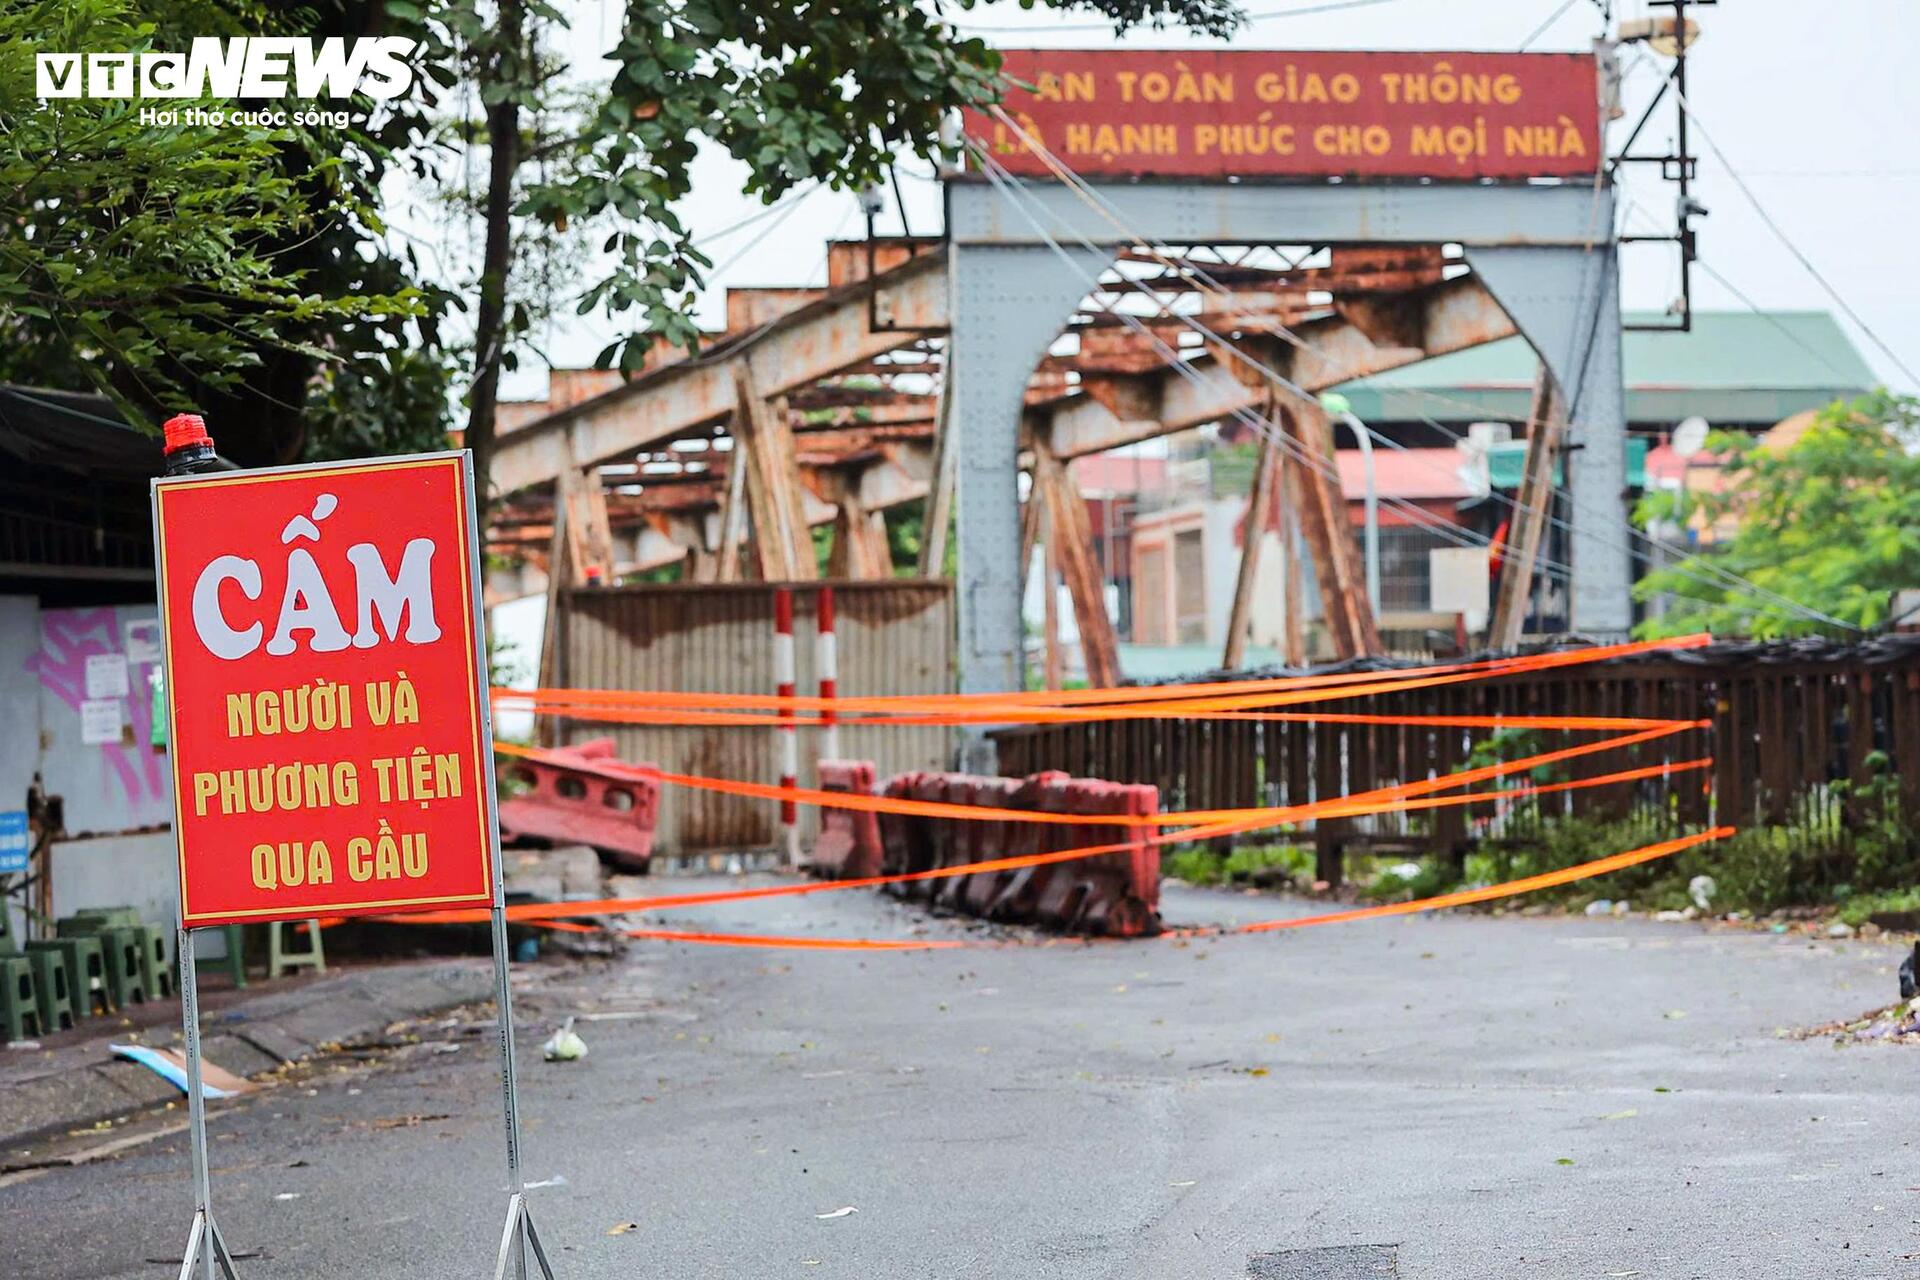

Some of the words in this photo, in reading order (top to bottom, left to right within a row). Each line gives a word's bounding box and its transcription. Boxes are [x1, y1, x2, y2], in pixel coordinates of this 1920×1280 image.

[1033, 71, 1096, 102] AN
[1116, 60, 1234, 103] TOÀN
[1381, 60, 1522, 104] THÔNG
[994, 112, 1046, 155] LÀ
[1065, 123, 1179, 163] HẠNH
[1194, 110, 1296, 156] PHÚC
[1312, 124, 1391, 156] CHO
[1503, 114, 1586, 157] NHÀ
[192, 493, 442, 660] CẤM
[226, 676, 352, 738] NGƯỜI
[365, 670, 420, 726] VÀ
[192, 760, 360, 817] PHƯƠNG
[371, 746, 463, 810] TIỆN
[250, 839, 334, 892] QUA
[346, 817, 429, 882] CẦU
